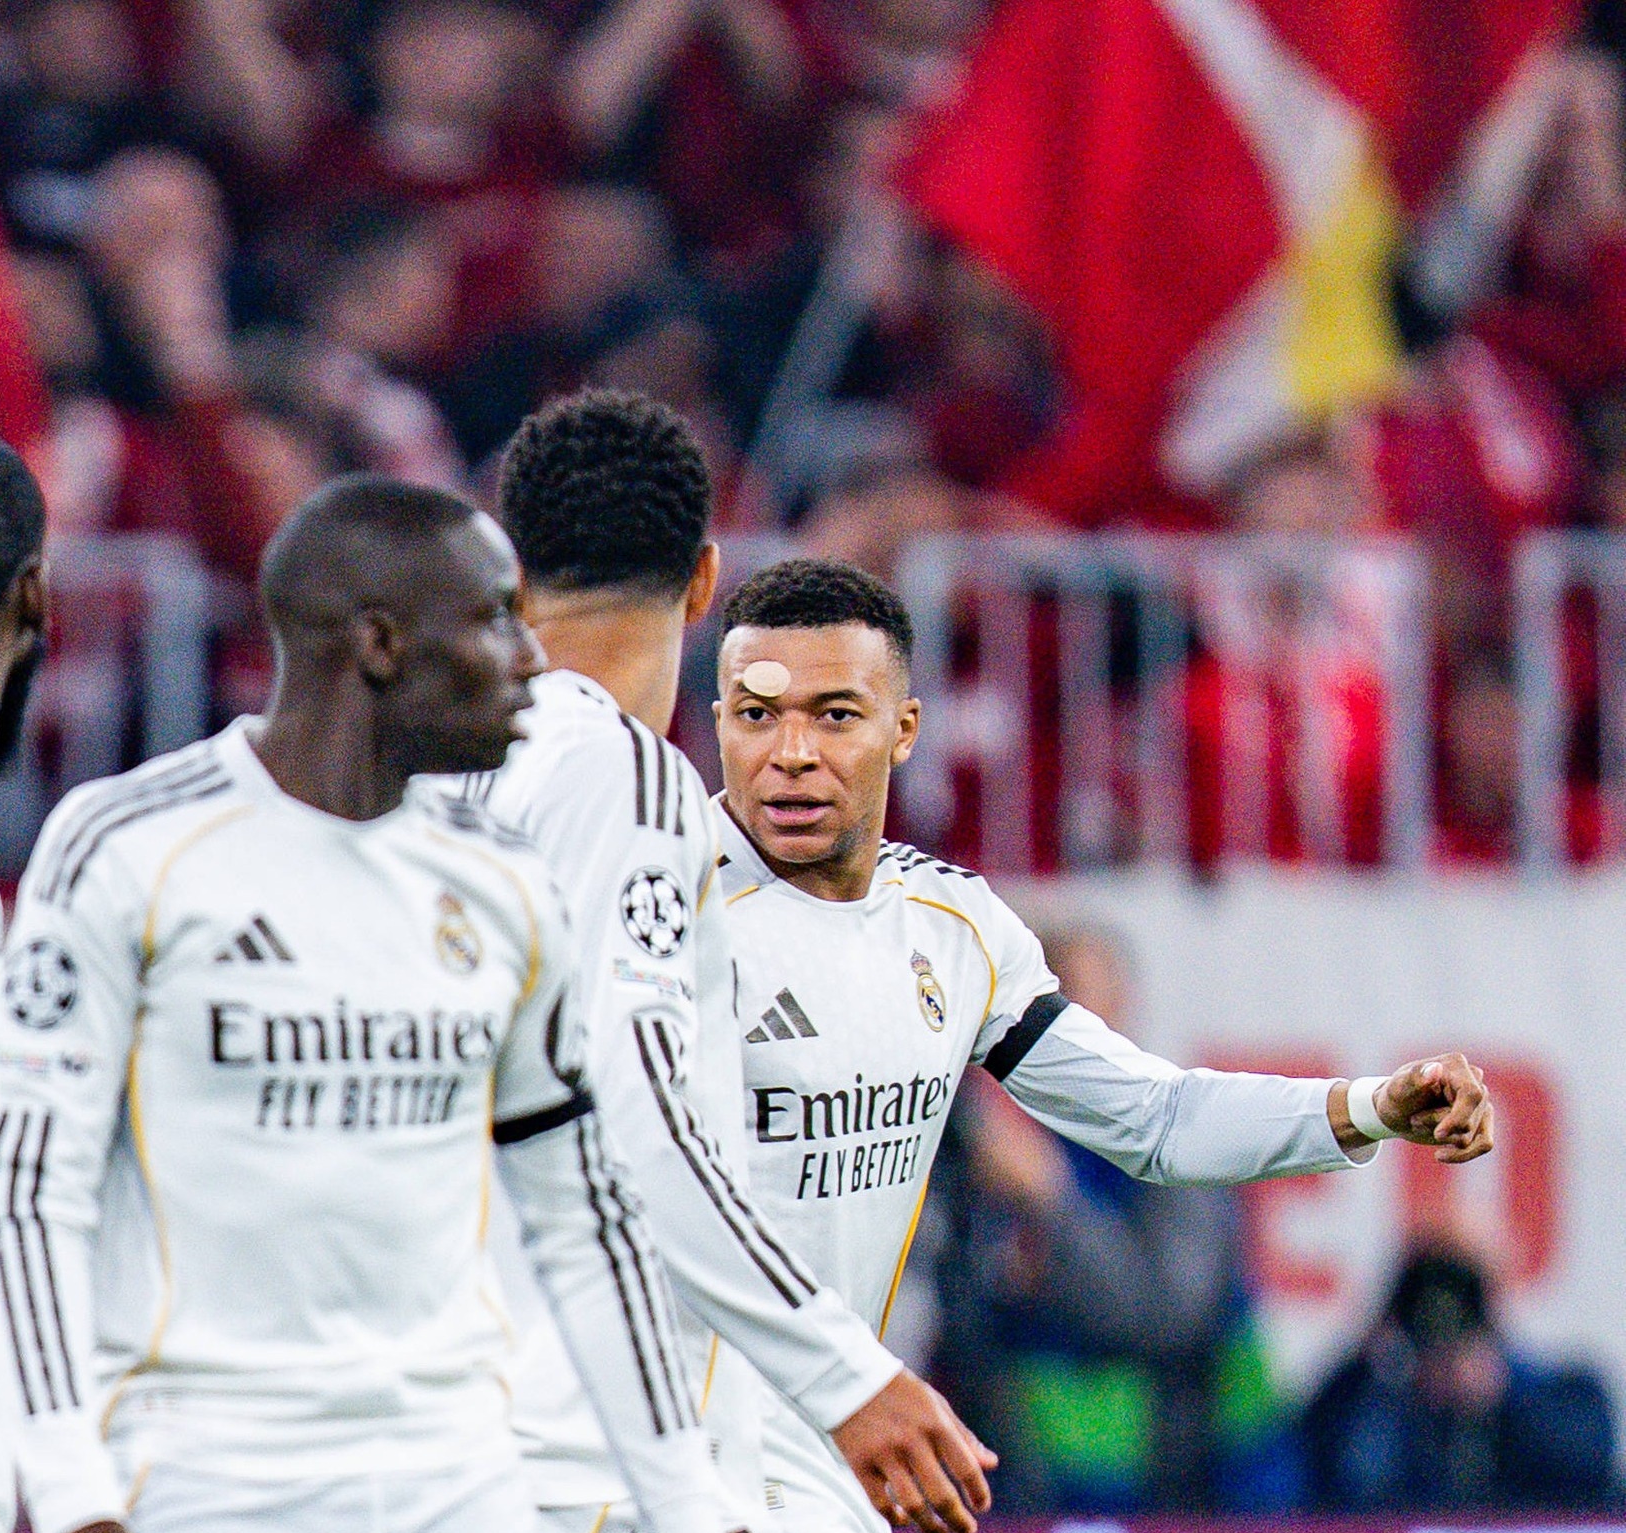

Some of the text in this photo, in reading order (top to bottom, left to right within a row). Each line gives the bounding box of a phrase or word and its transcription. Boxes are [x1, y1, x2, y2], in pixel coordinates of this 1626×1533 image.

[207, 992, 497, 1065] Emirates
[751, 1070, 951, 1143] Emirates
[796, 1134, 922, 1200] FLY BETTER
